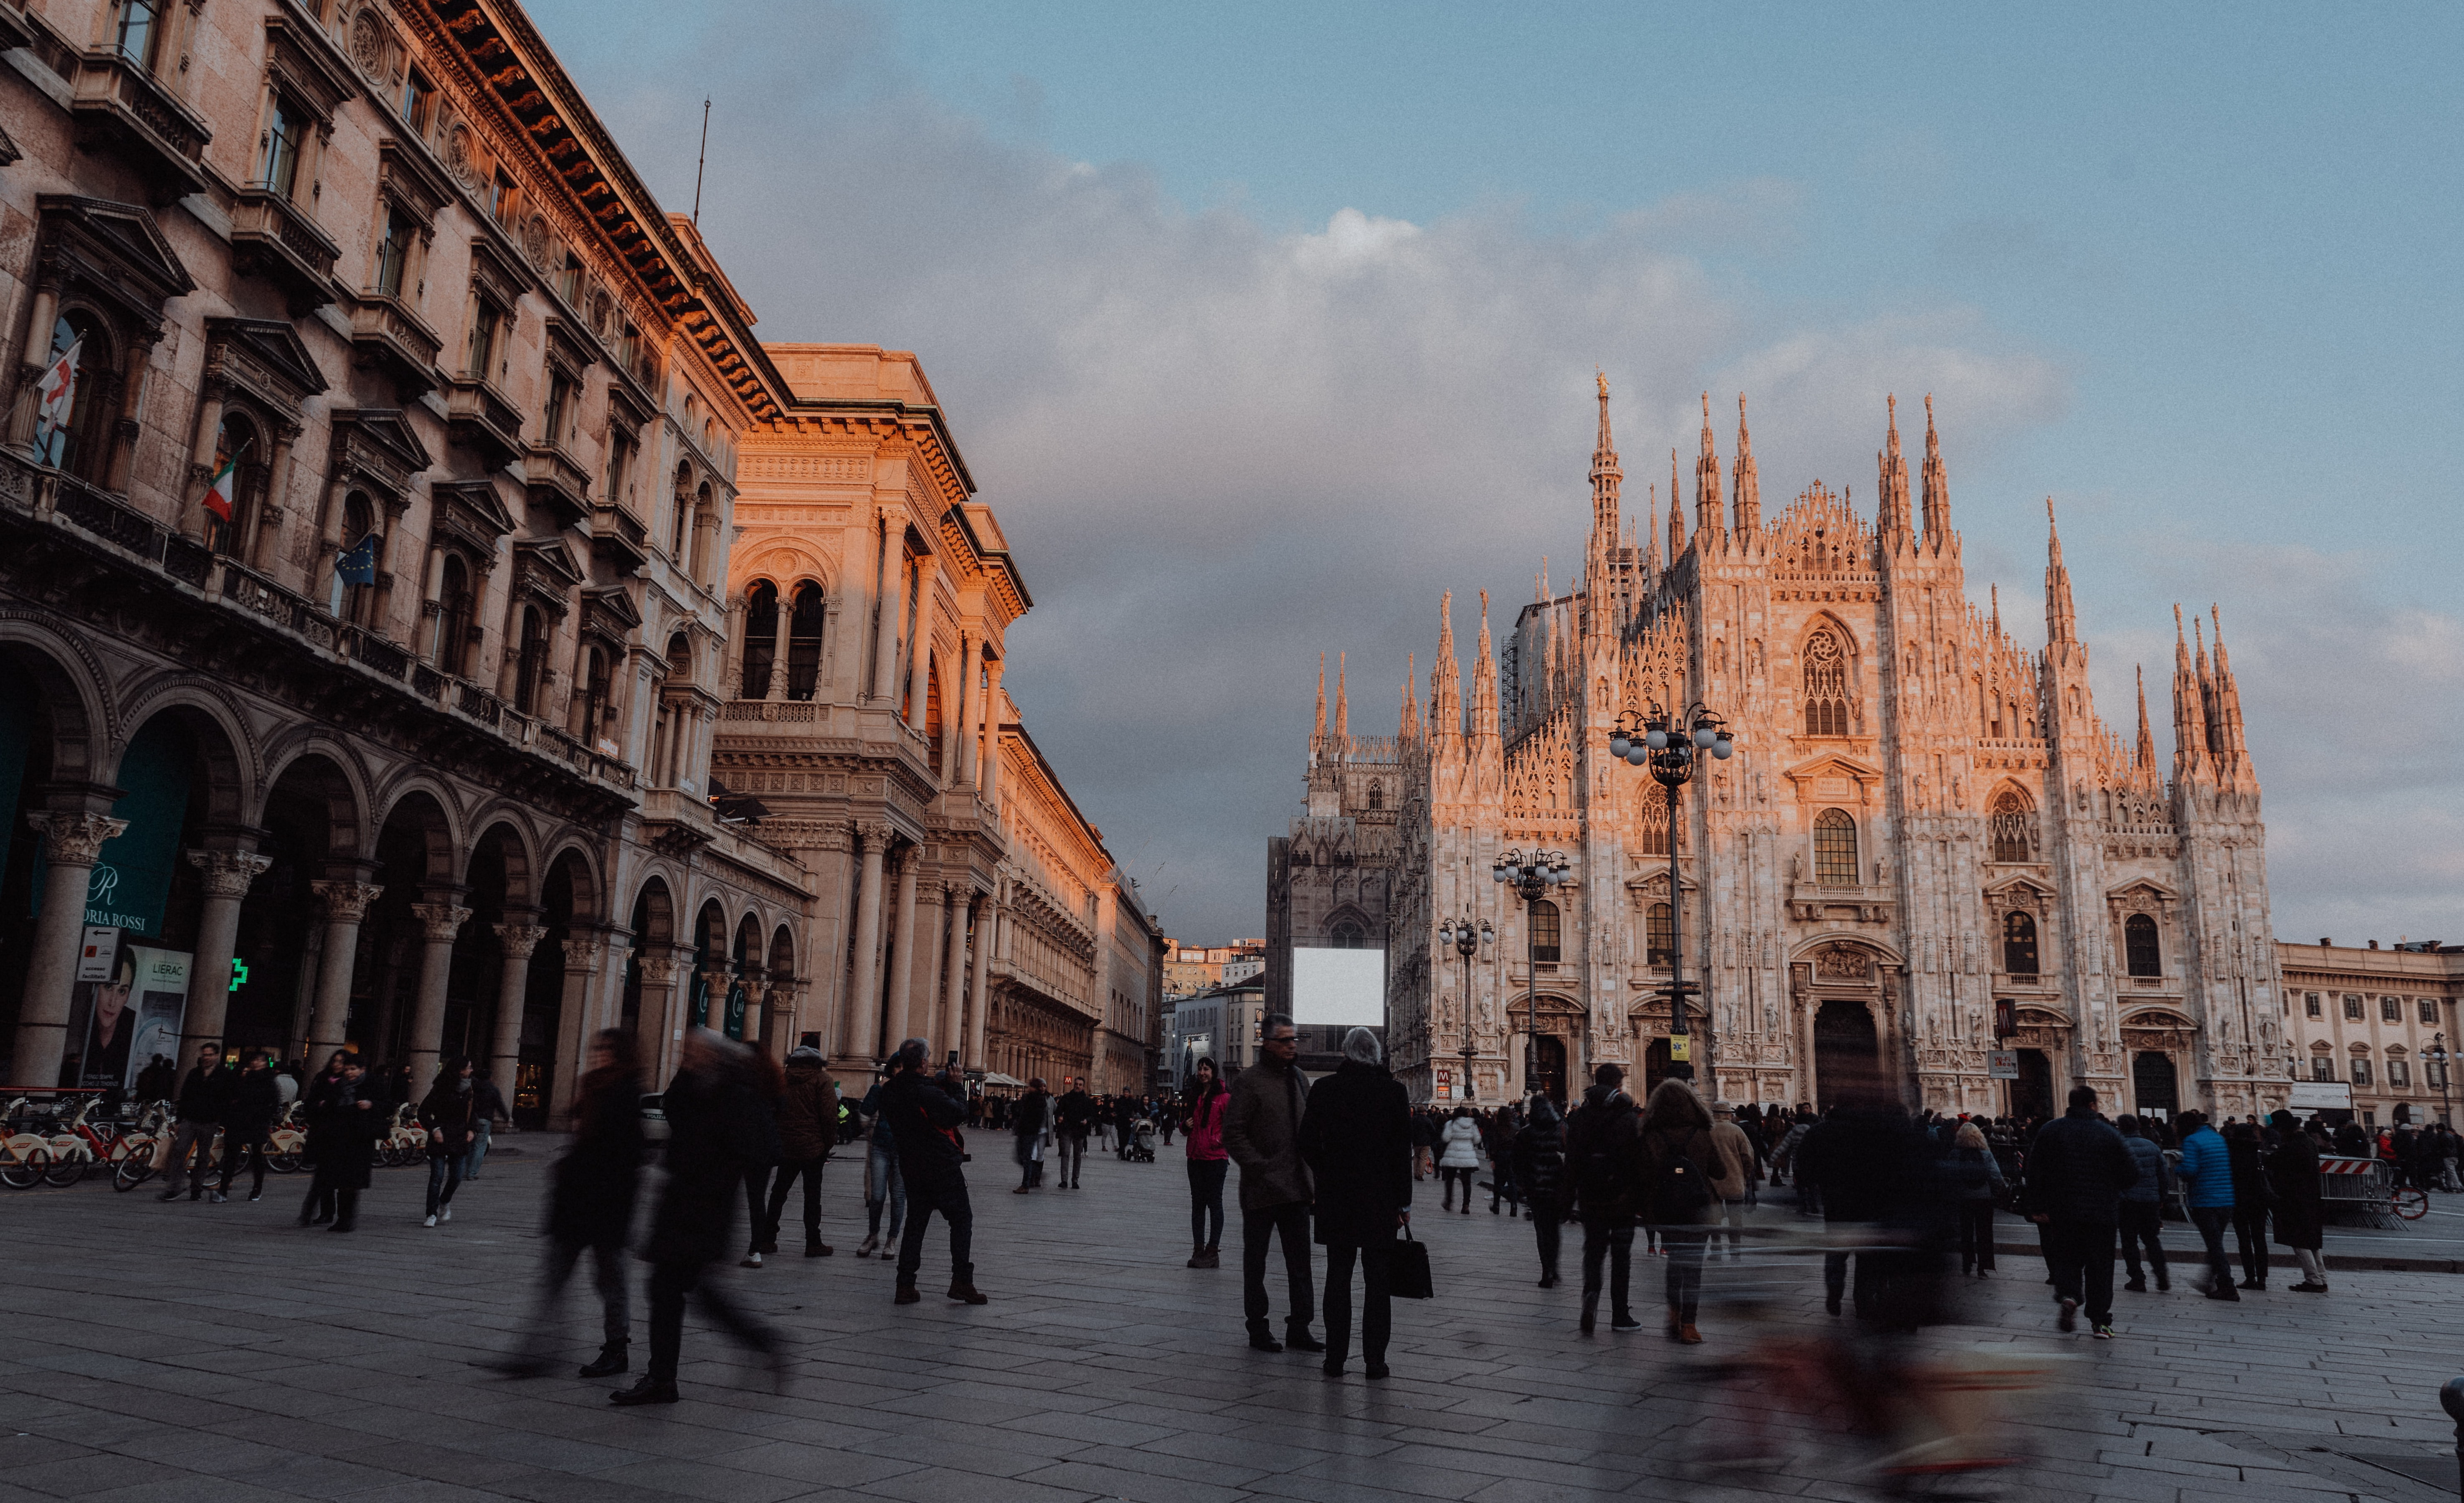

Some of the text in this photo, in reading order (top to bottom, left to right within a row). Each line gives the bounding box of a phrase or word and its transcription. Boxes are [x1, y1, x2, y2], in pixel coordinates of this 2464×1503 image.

[112, 913, 146, 931] ROSSI
[152, 963, 183, 976] LIERAC
[1999, 1009, 2010, 1029] M
[1438, 1072, 1448, 1080] M
